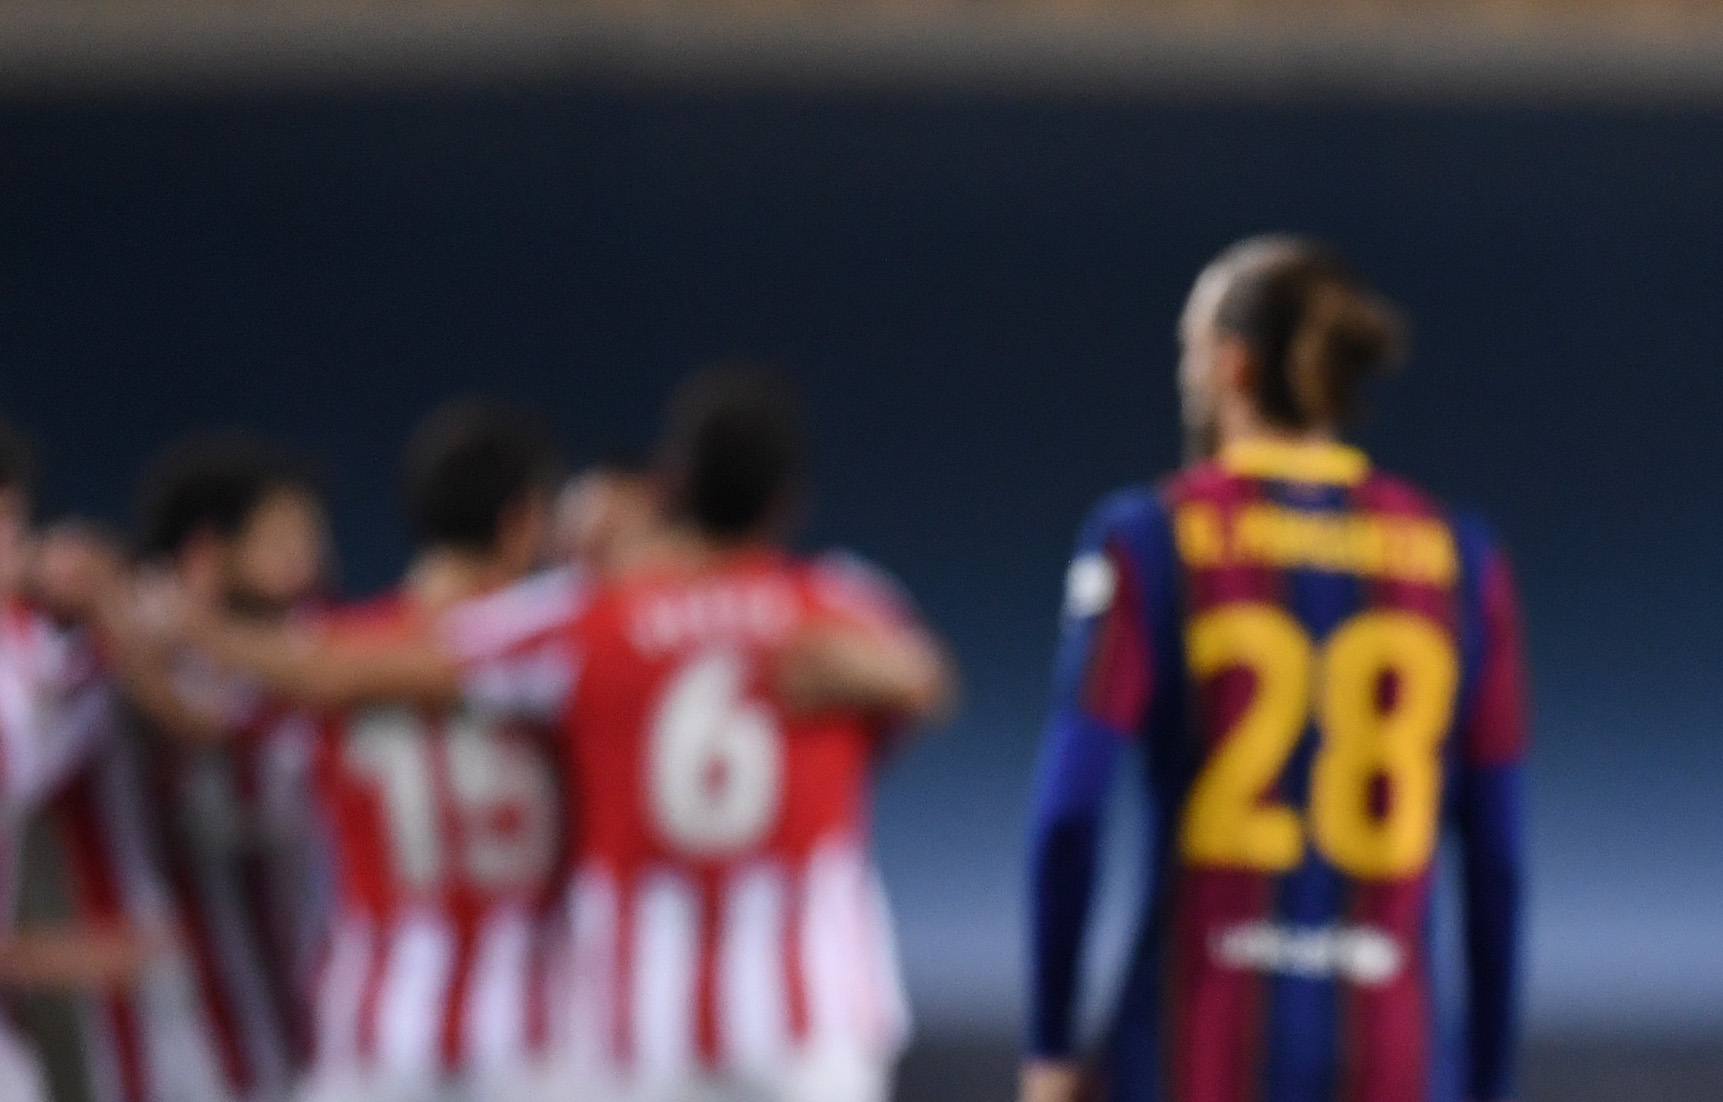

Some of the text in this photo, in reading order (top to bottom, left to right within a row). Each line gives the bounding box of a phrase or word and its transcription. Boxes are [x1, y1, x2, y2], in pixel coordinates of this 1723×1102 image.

[341, 704, 566, 892] 15
[644, 649, 787, 855] 6
[1180, 601, 1461, 880] 28
